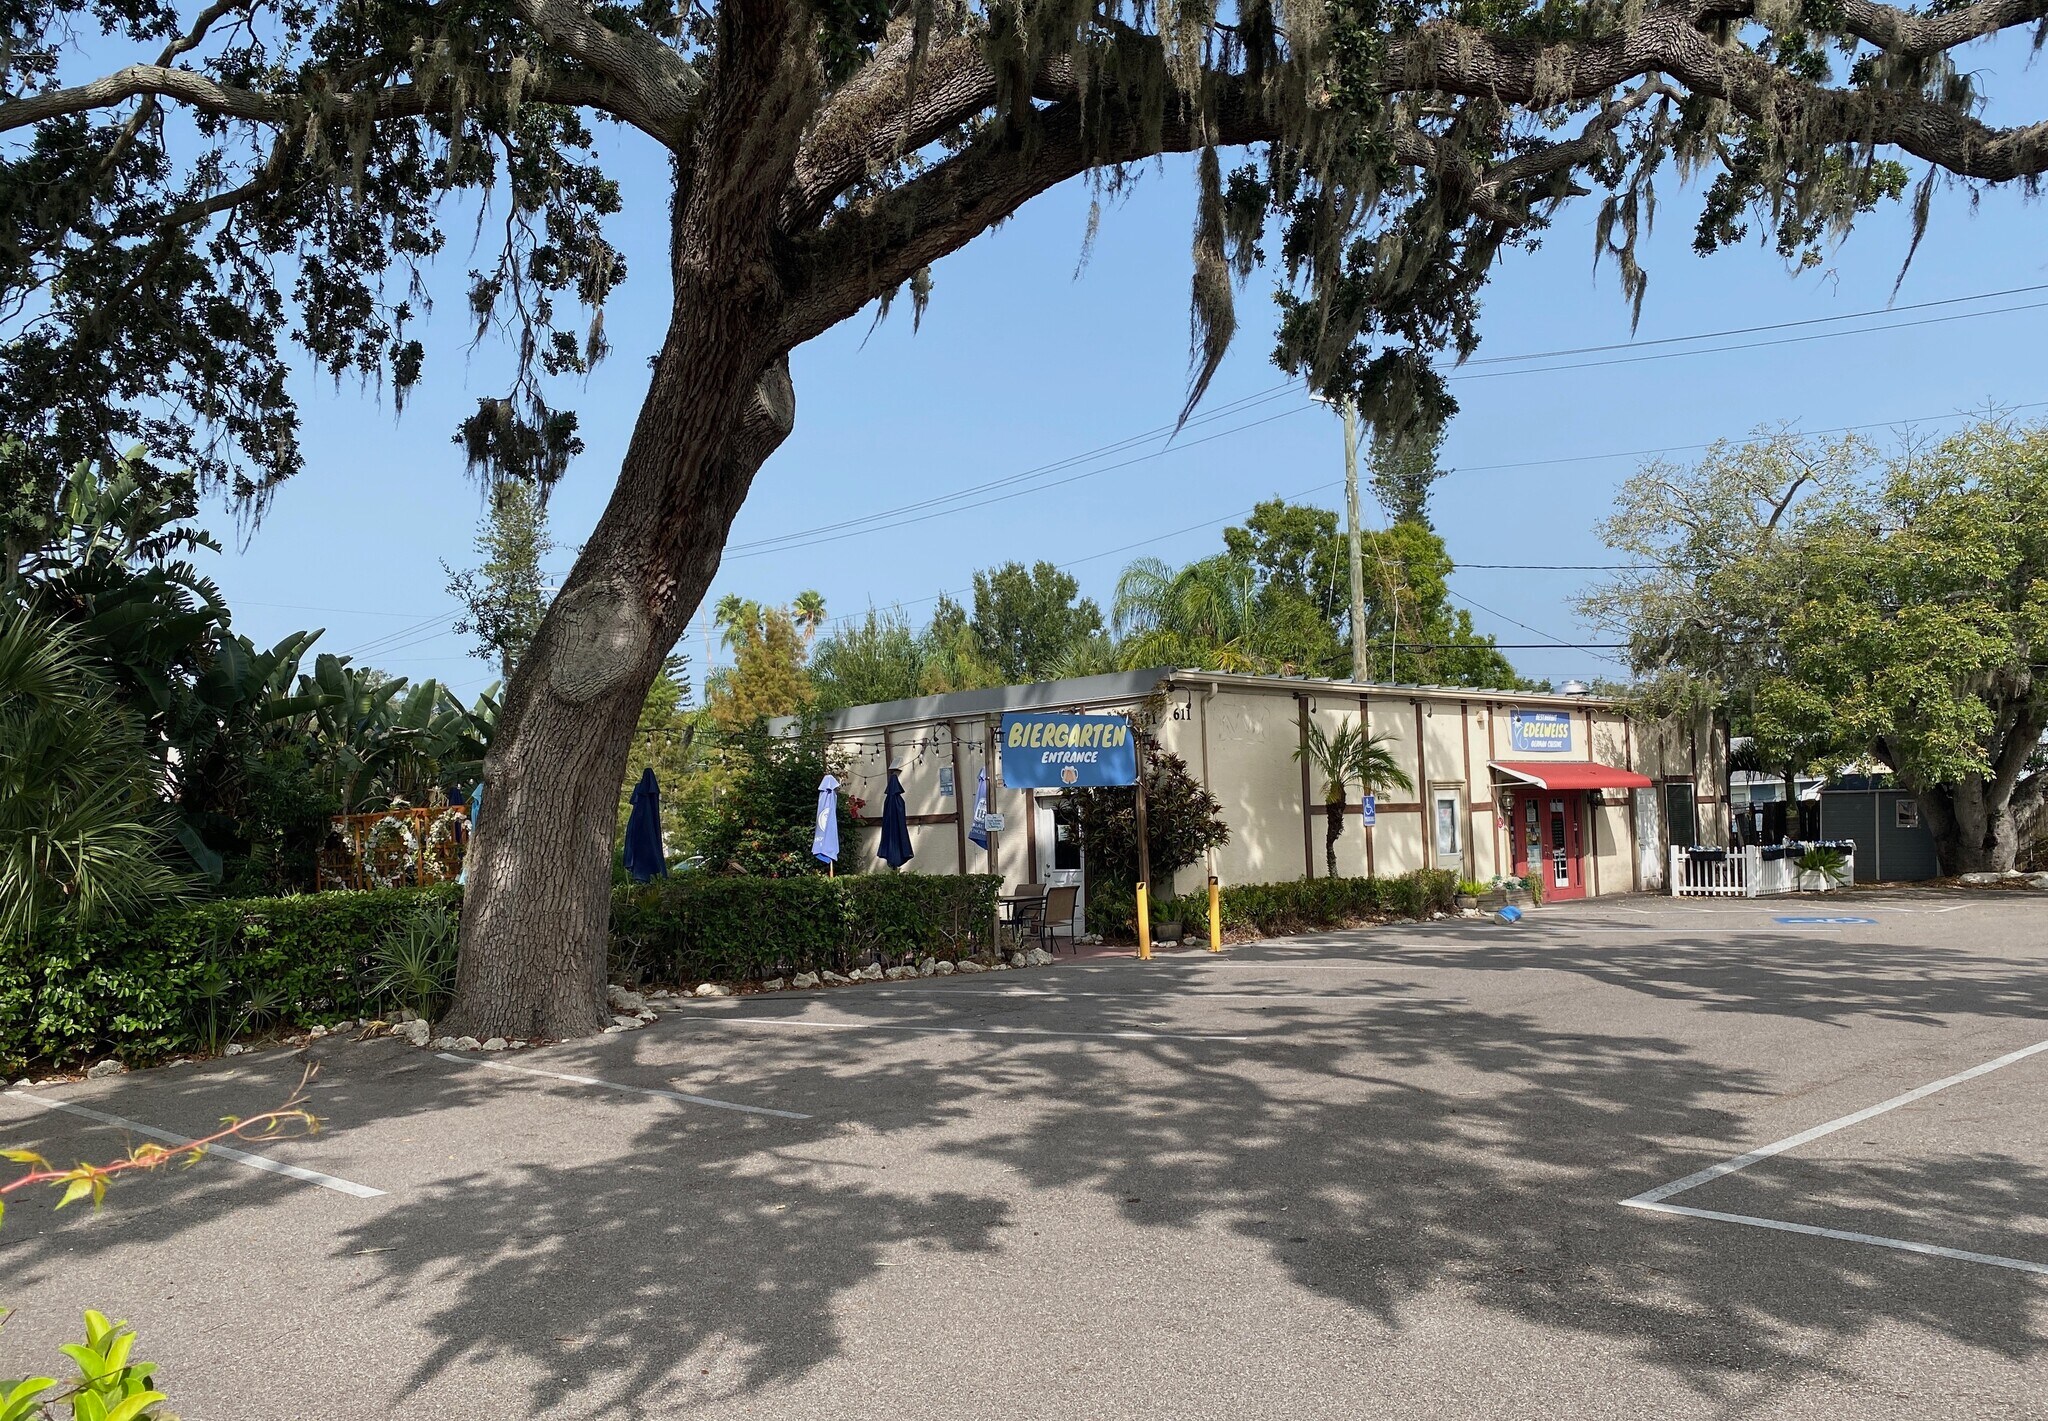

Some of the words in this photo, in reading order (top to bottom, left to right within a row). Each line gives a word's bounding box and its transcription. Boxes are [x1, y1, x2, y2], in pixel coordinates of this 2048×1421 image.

[1173, 708, 1191, 721] 611
[1008, 722, 1127, 748] BIERGARTEN
[1523, 722, 1569, 738] EDELWEISS
[1041, 751, 1097, 763] ENTRANCE
